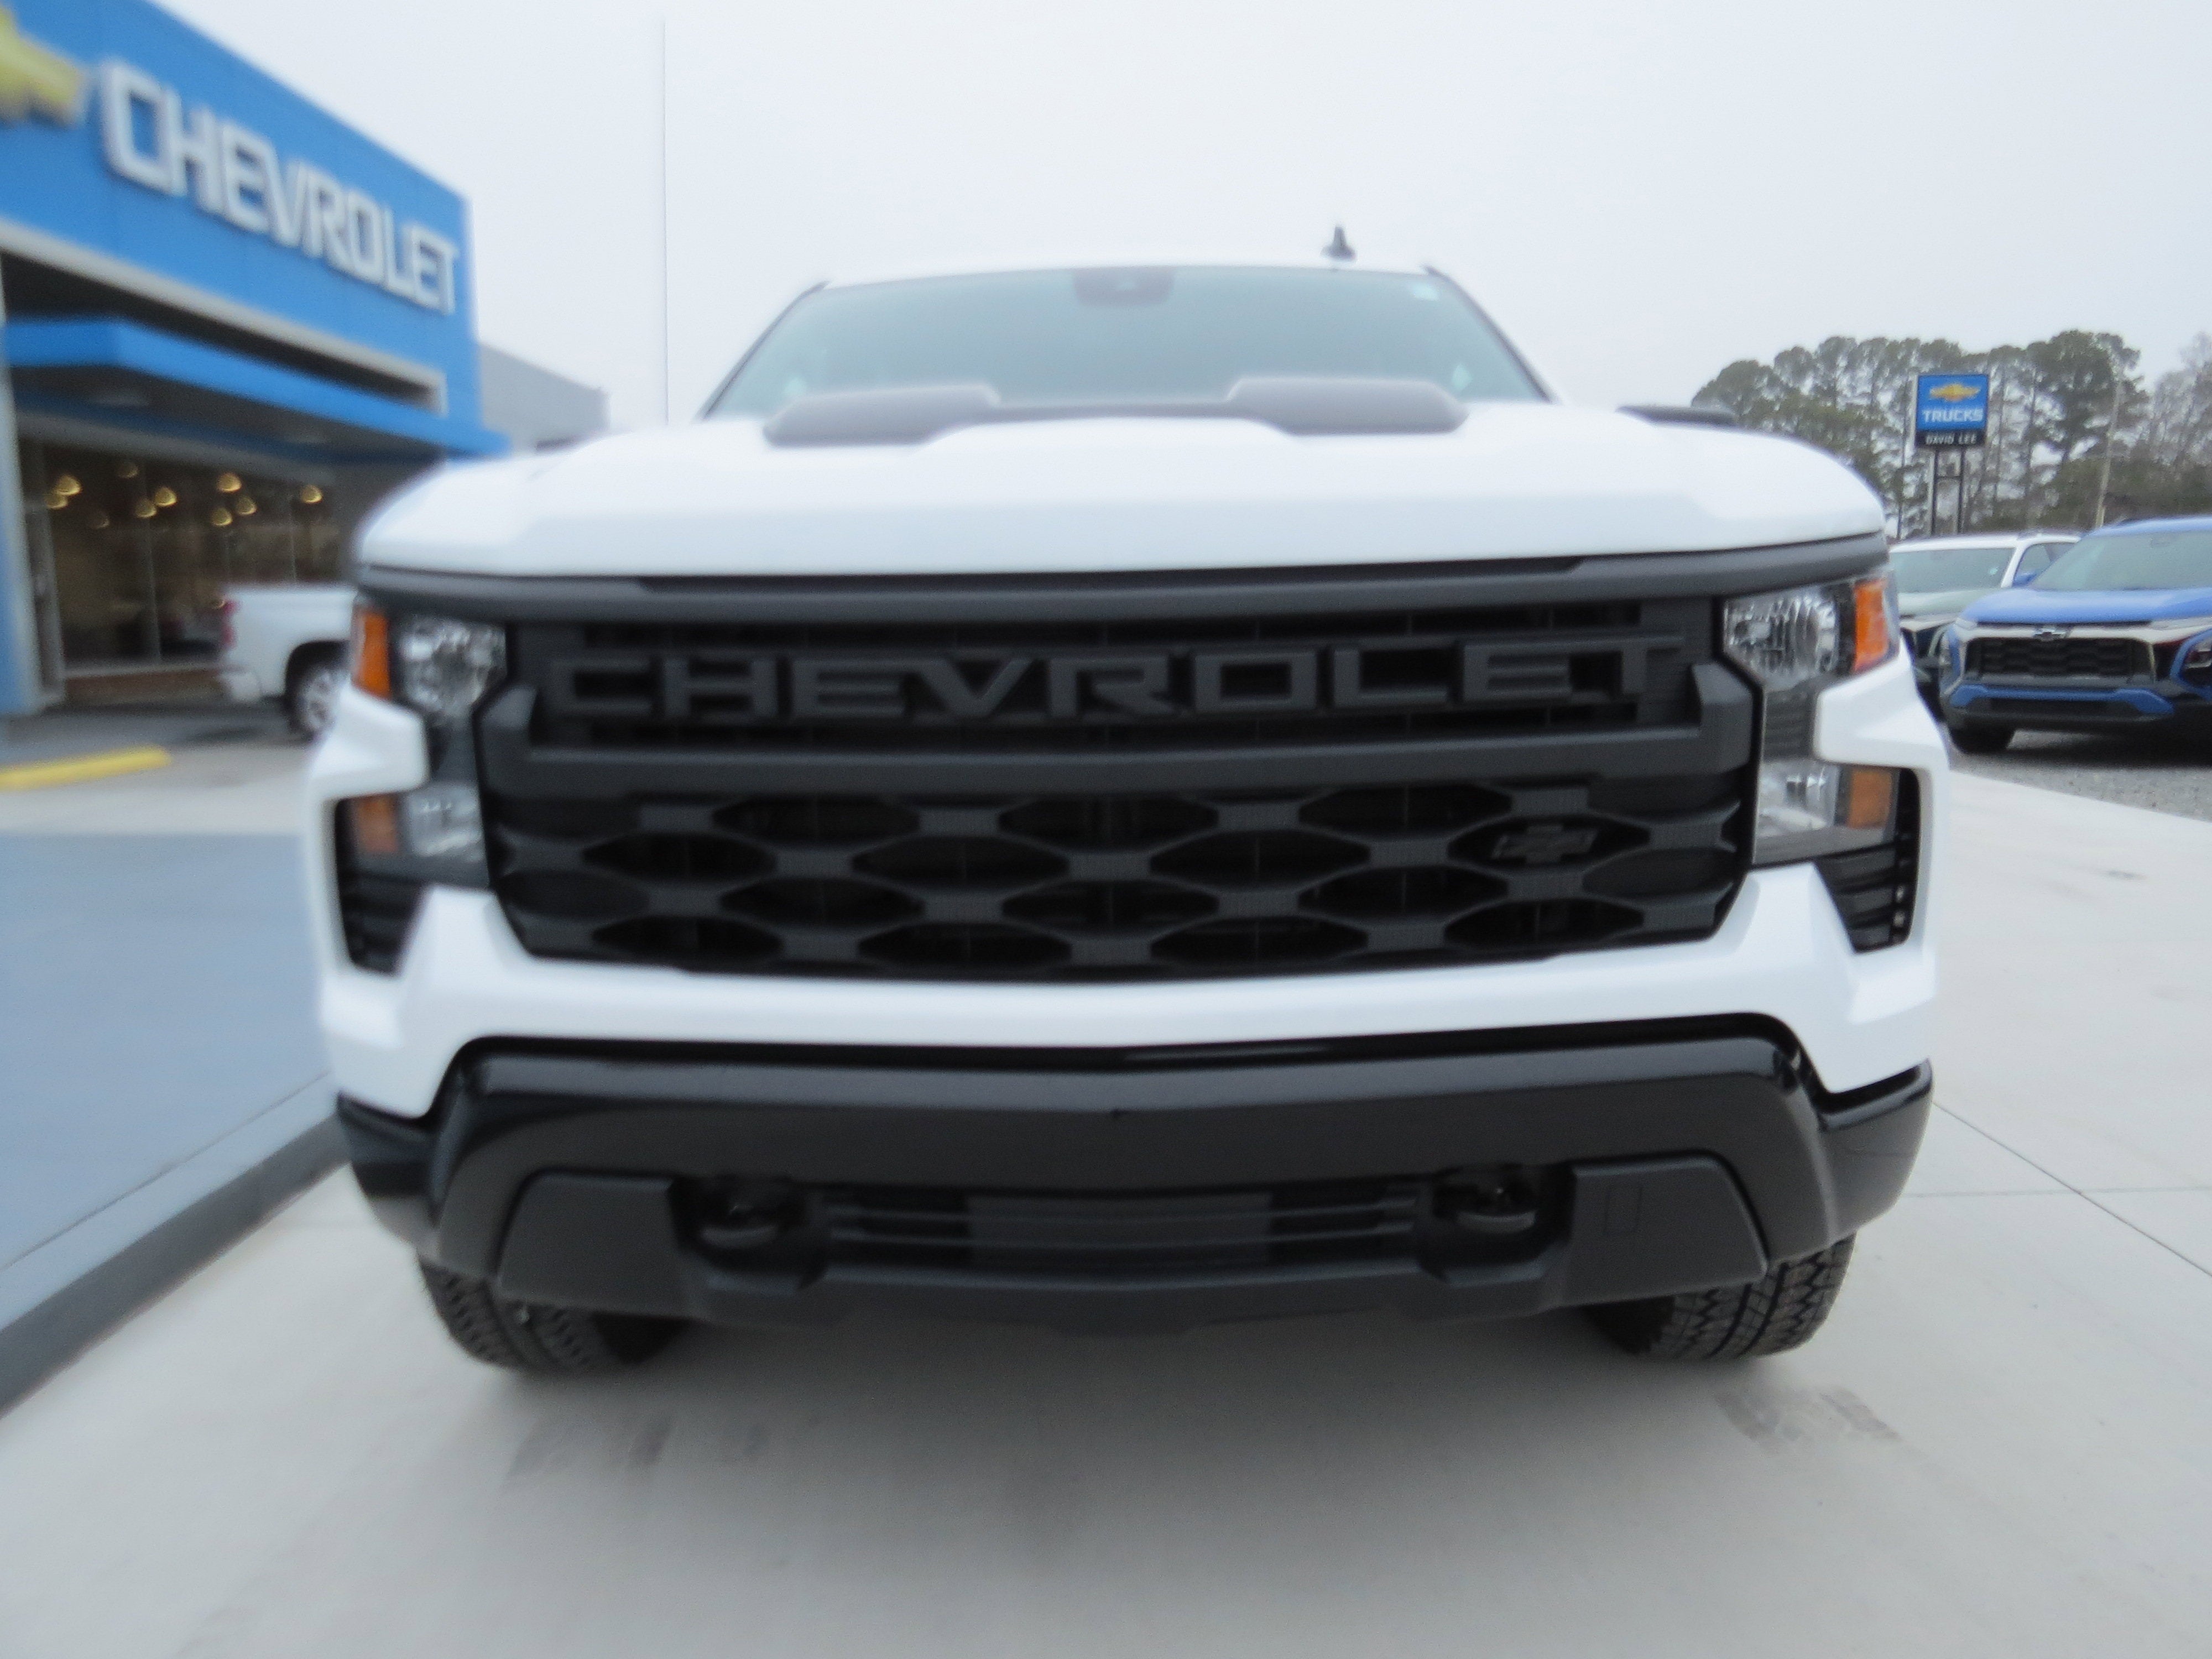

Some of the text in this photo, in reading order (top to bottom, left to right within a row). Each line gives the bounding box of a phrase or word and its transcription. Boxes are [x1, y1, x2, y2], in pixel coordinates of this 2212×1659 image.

[102, 62, 458, 315] CHEVROLET
[1922, 409, 1984, 422] TRUCKS
[1926, 433, 1978, 445] DAVID LEE
[549, 634, 1685, 721] CHEVROLET
